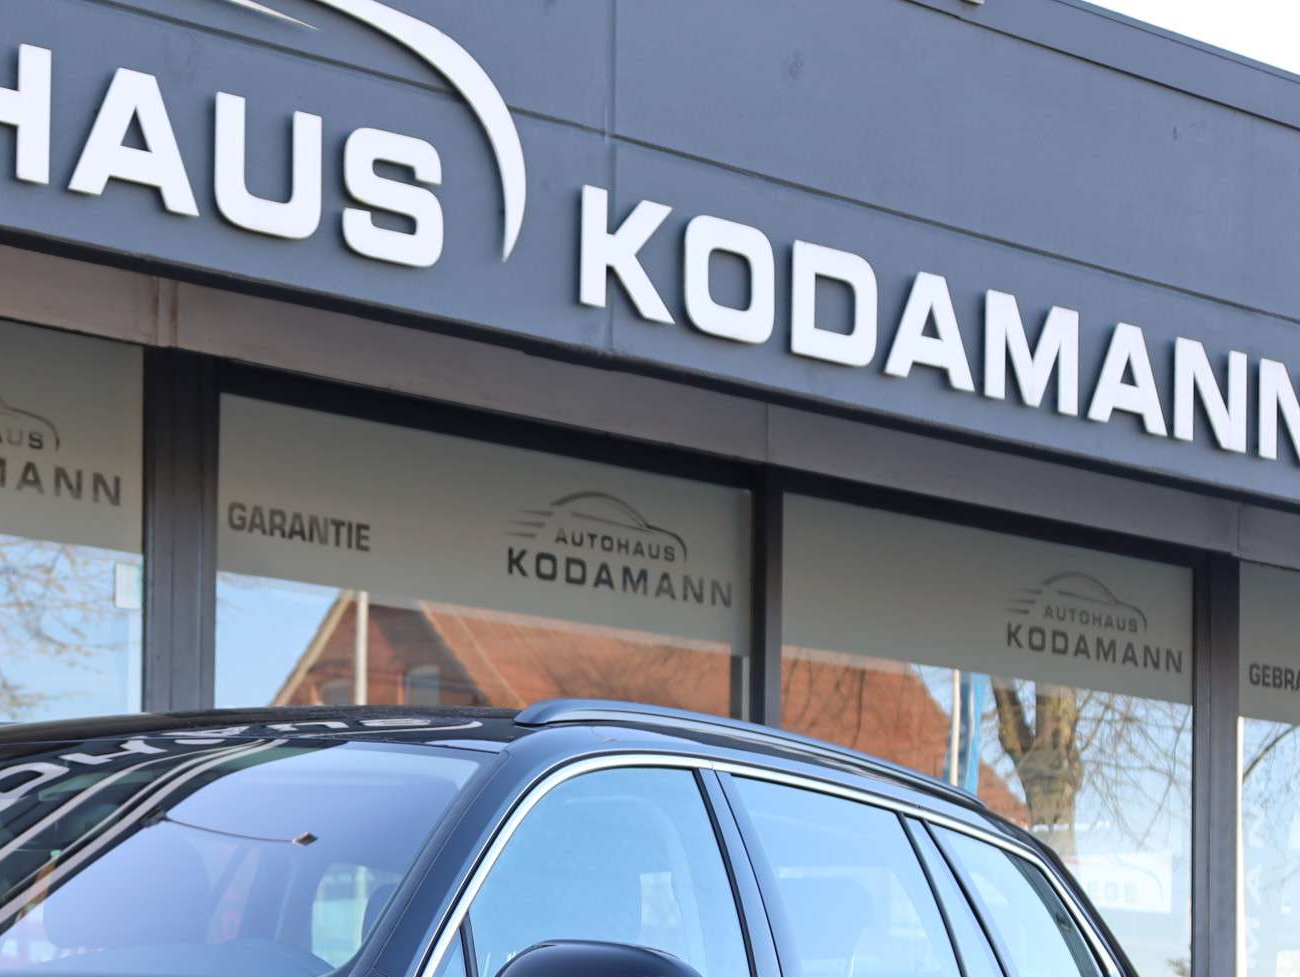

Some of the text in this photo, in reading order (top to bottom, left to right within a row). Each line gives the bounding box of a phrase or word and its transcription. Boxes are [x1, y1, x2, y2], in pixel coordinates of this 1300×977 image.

[579, 184, 1300, 464] KODAMANN
[227, 500, 371, 553] GARANTIE
[555, 528, 676, 562] AUTOHAUS
[507, 547, 733, 608] KODAMANN
[1044, 605, 1138, 633] AUTOHAUS
[1006, 622, 1183, 674] KODAMANN
